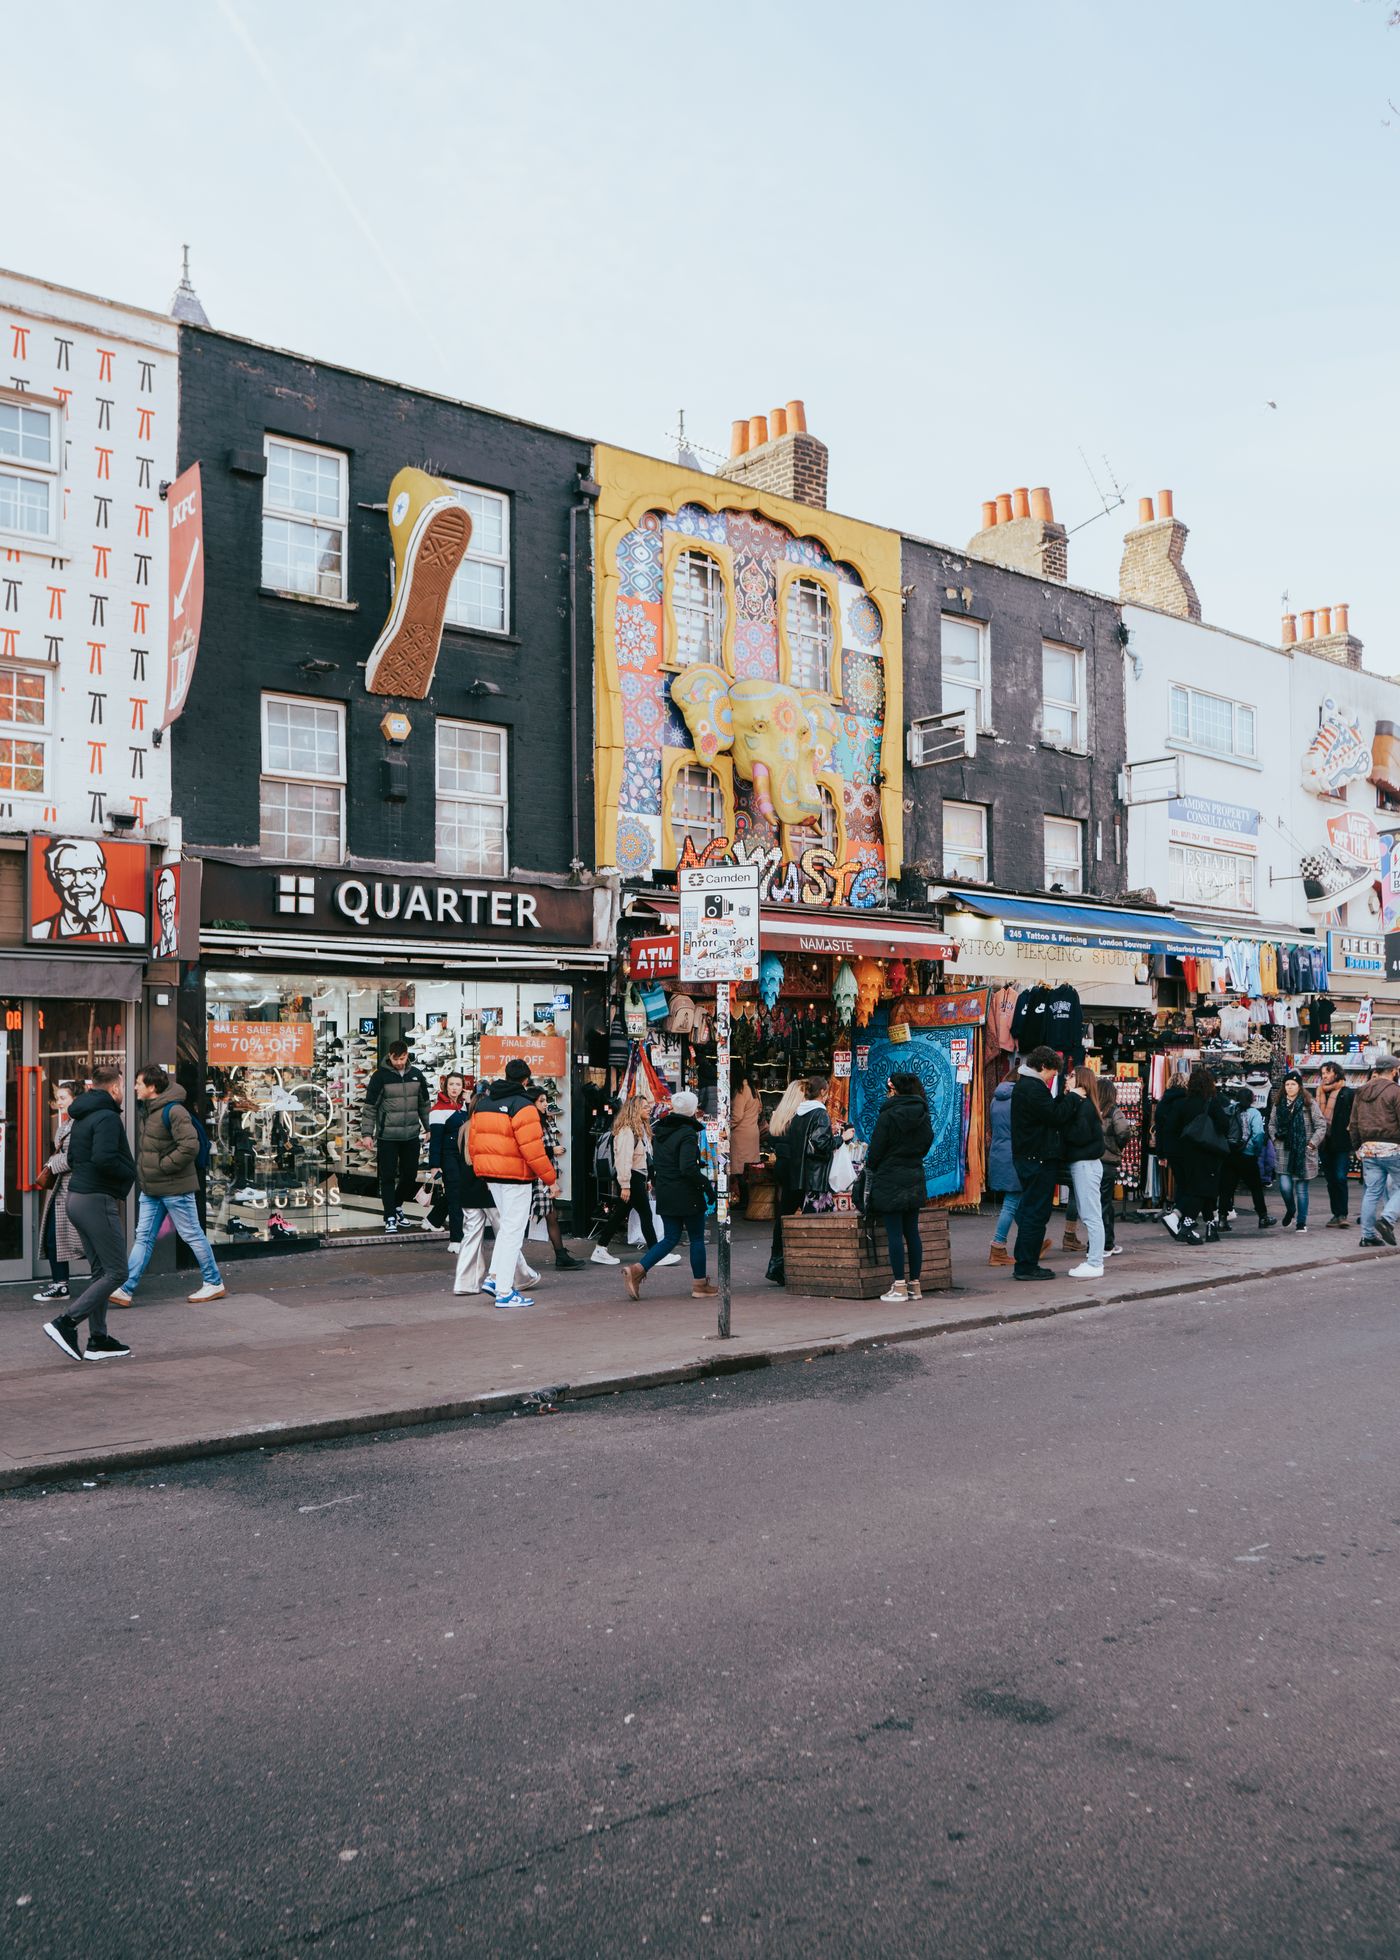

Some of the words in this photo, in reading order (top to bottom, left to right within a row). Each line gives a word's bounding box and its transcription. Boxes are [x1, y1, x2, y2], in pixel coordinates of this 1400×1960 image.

[172, 491, 196, 529] KFC
[1177, 798, 1212, 813] CAMDEN
[1212, 803, 1250, 820] PROPERTY
[1187, 810, 1243, 831] CONSULTANCY
[1186, 850, 1235, 870] ESTATE
[677, 835, 879, 909] NMASTE
[706, 873, 751, 884] Camden
[337, 880, 541, 928] QUARTER
[800, 937, 855, 952] NAMASTE
[940, 946, 952, 958] 24
[958, 938, 1006, 957] ATTOO
[1017, 943, 1082, 963] PIERCING
[1092, 949, 1138, 966] STUDIO
[1009, 929, 1022, 938] 245
[1026, 931, 1050, 941] Tattoo
[1058, 934, 1088, 946] Piercing
[1098, 938, 1123, 947] London
[1124, 940, 1151, 950] Souvenir
[1196, 945, 1220, 957] Clothing
[637, 946, 673, 970] ATM
[6, 1010, 44, 1031] ORR
[213, 1024, 239, 1034] SALE
[246, 1026, 271, 1034] SALE
[279, 1026, 304, 1035] SALE
[230, 1037, 264, 1052] 70%
[269, 1038, 302, 1053] OFF
[501, 1040, 524, 1048] FINAL
[526, 1040, 547, 1048] SALE
[523, 1055, 545, 1065] OFF
[1119, 1064, 1135, 1078] £1
